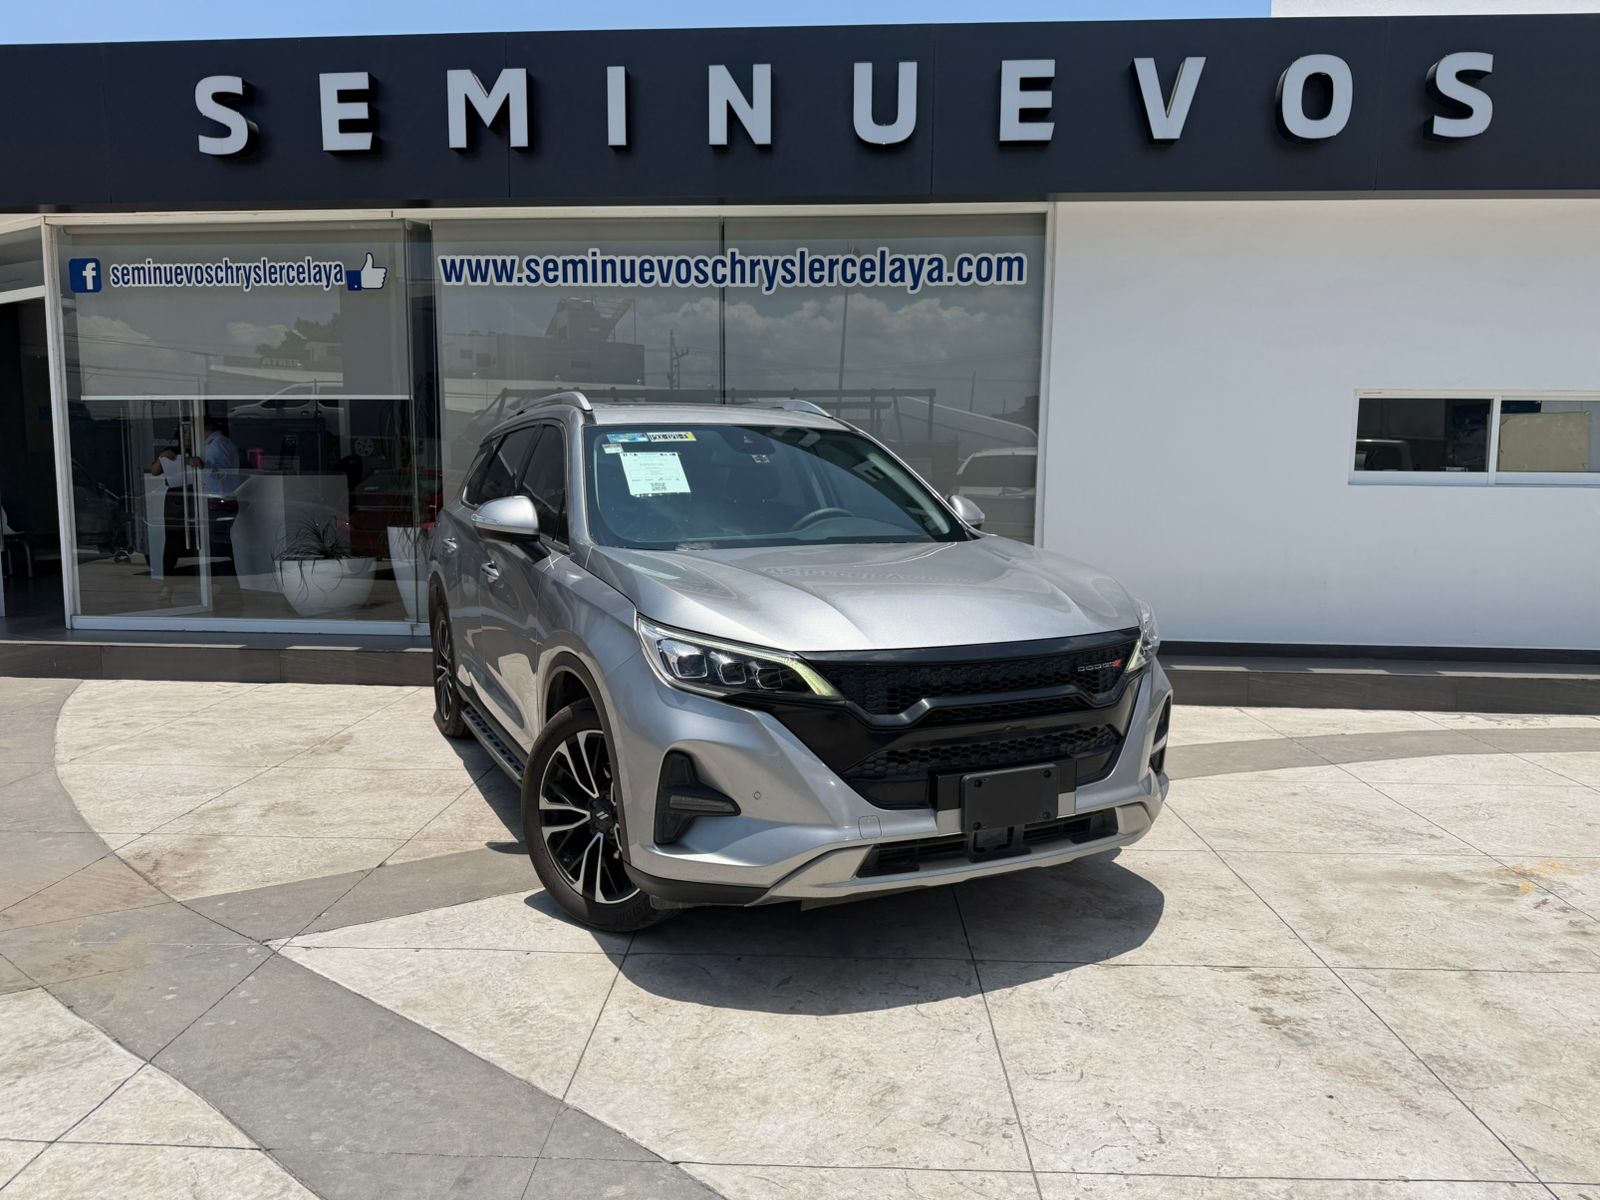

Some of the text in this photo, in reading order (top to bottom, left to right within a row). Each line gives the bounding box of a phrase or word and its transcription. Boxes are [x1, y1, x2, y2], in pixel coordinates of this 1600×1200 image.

[194, 51, 1495, 156] SEMINUEVOS
[110, 257, 344, 290] seminuevoschryslercelaya
[438, 247, 1028, 294] www.seminuevoschryslercelaya.com
